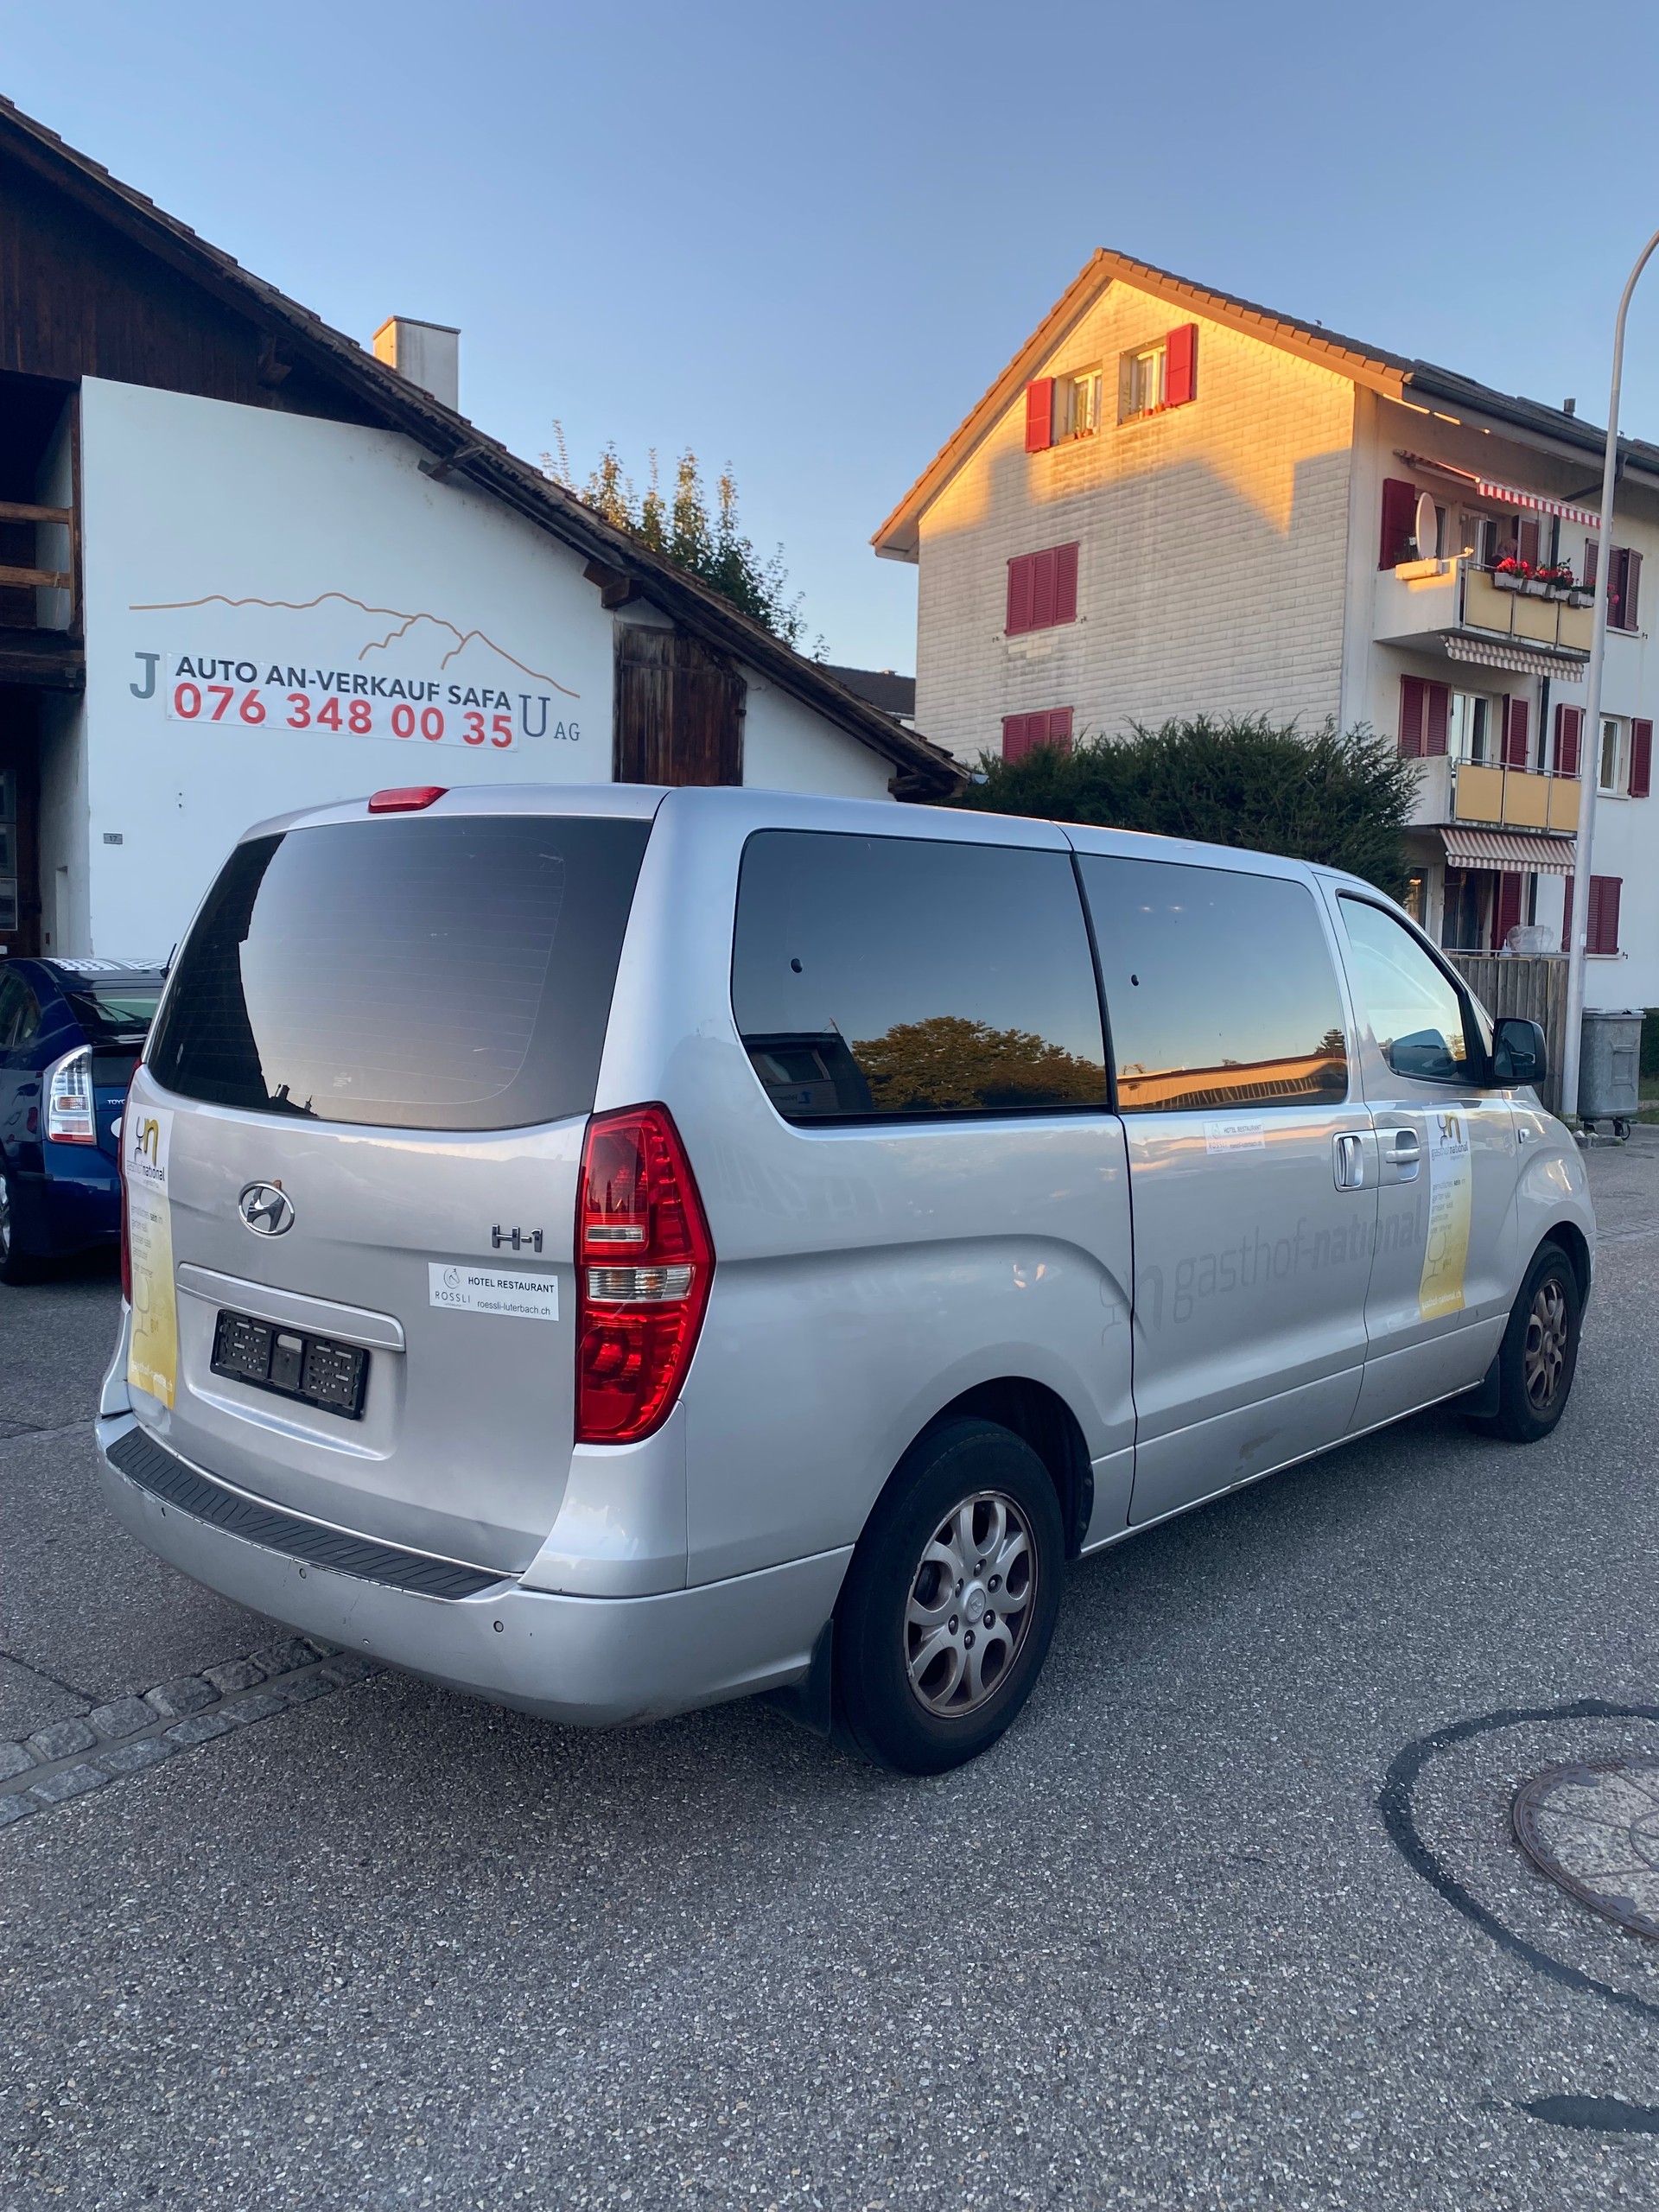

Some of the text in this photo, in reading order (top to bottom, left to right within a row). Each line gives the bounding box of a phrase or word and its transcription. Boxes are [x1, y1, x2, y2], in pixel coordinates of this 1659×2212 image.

[129, 652, 581, 741] J U AG
[175, 657, 512, 710] AUTO AN-VERKAUF SAFA
[175, 683, 512, 748] 076 348 00 35
[492, 1224, 543, 1253] H-1
[468, 1276, 555, 1294] HOTEL RESTAURANT
[477, 1300, 550, 1315] roessli-luterbach.ch
